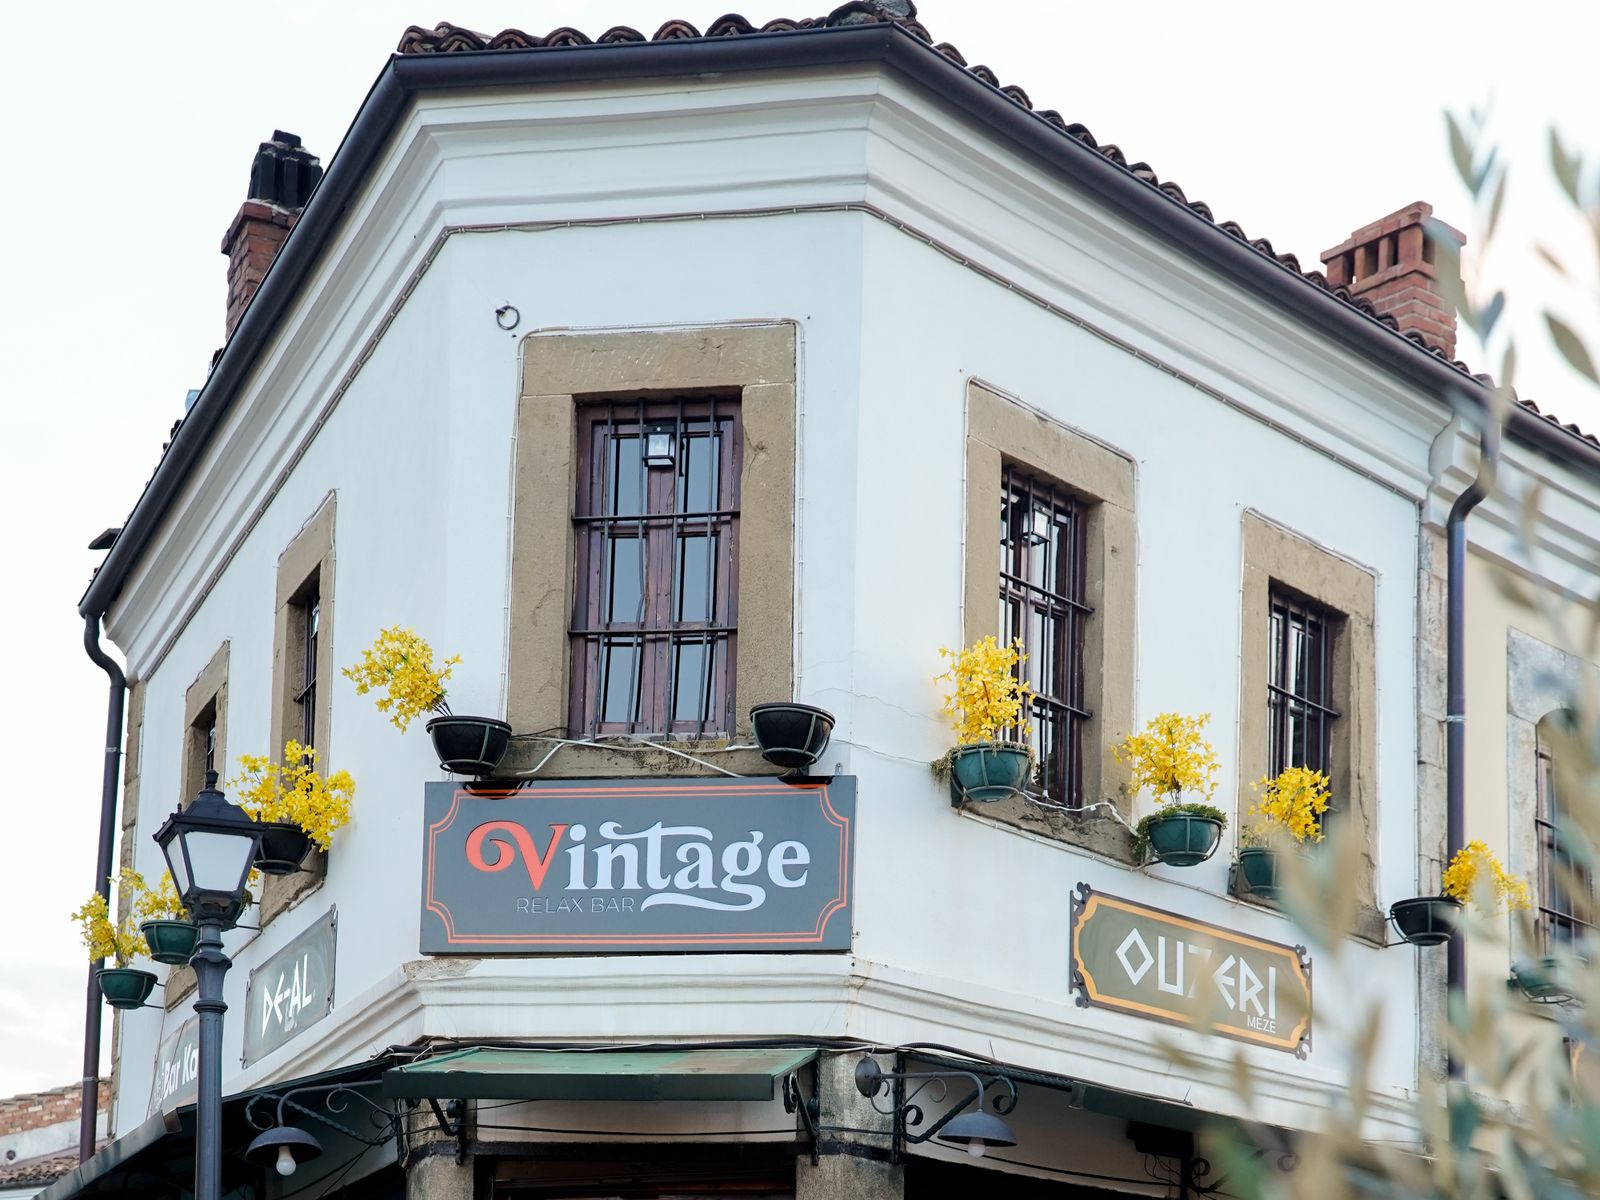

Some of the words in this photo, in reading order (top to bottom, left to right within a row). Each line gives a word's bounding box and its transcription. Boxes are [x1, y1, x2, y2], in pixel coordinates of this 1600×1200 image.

[464, 819, 811, 913] Vintage
[516, 896, 584, 914] RELAX
[590, 896, 636, 913] BAR
[1247, 1014, 1277, 1034] MEZE
